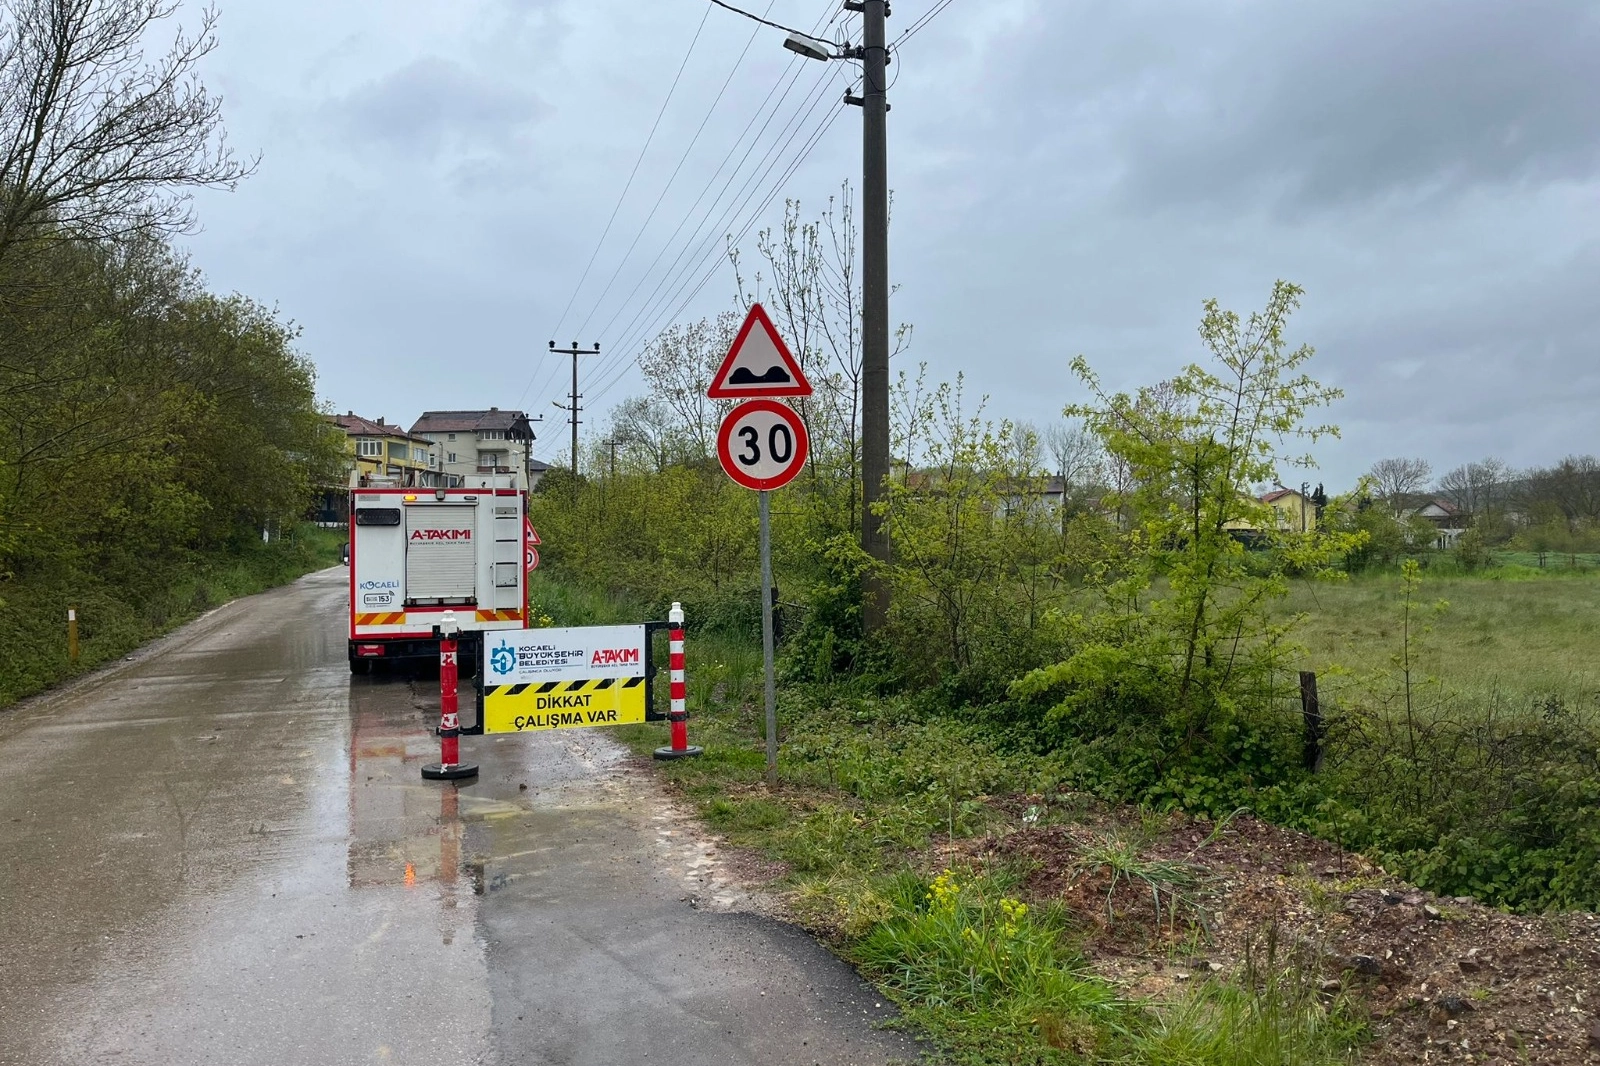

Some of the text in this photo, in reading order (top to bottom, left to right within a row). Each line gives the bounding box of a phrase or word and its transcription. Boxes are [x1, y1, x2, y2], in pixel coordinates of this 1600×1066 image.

[738, 424, 792, 466] 30
[411, 529, 471, 540] A-TAKIMI
[360, 580, 399, 590] KOCAELİ
[519, 650, 584, 660] BÜYÜKŞEHİR
[591, 648, 639, 664] A-TAKIMI
[519, 659, 568, 667] BELEDİYESİ
[536, 694, 592, 709] DİKKAT
[514, 710, 617, 731] ÇALIŞMA VAR
